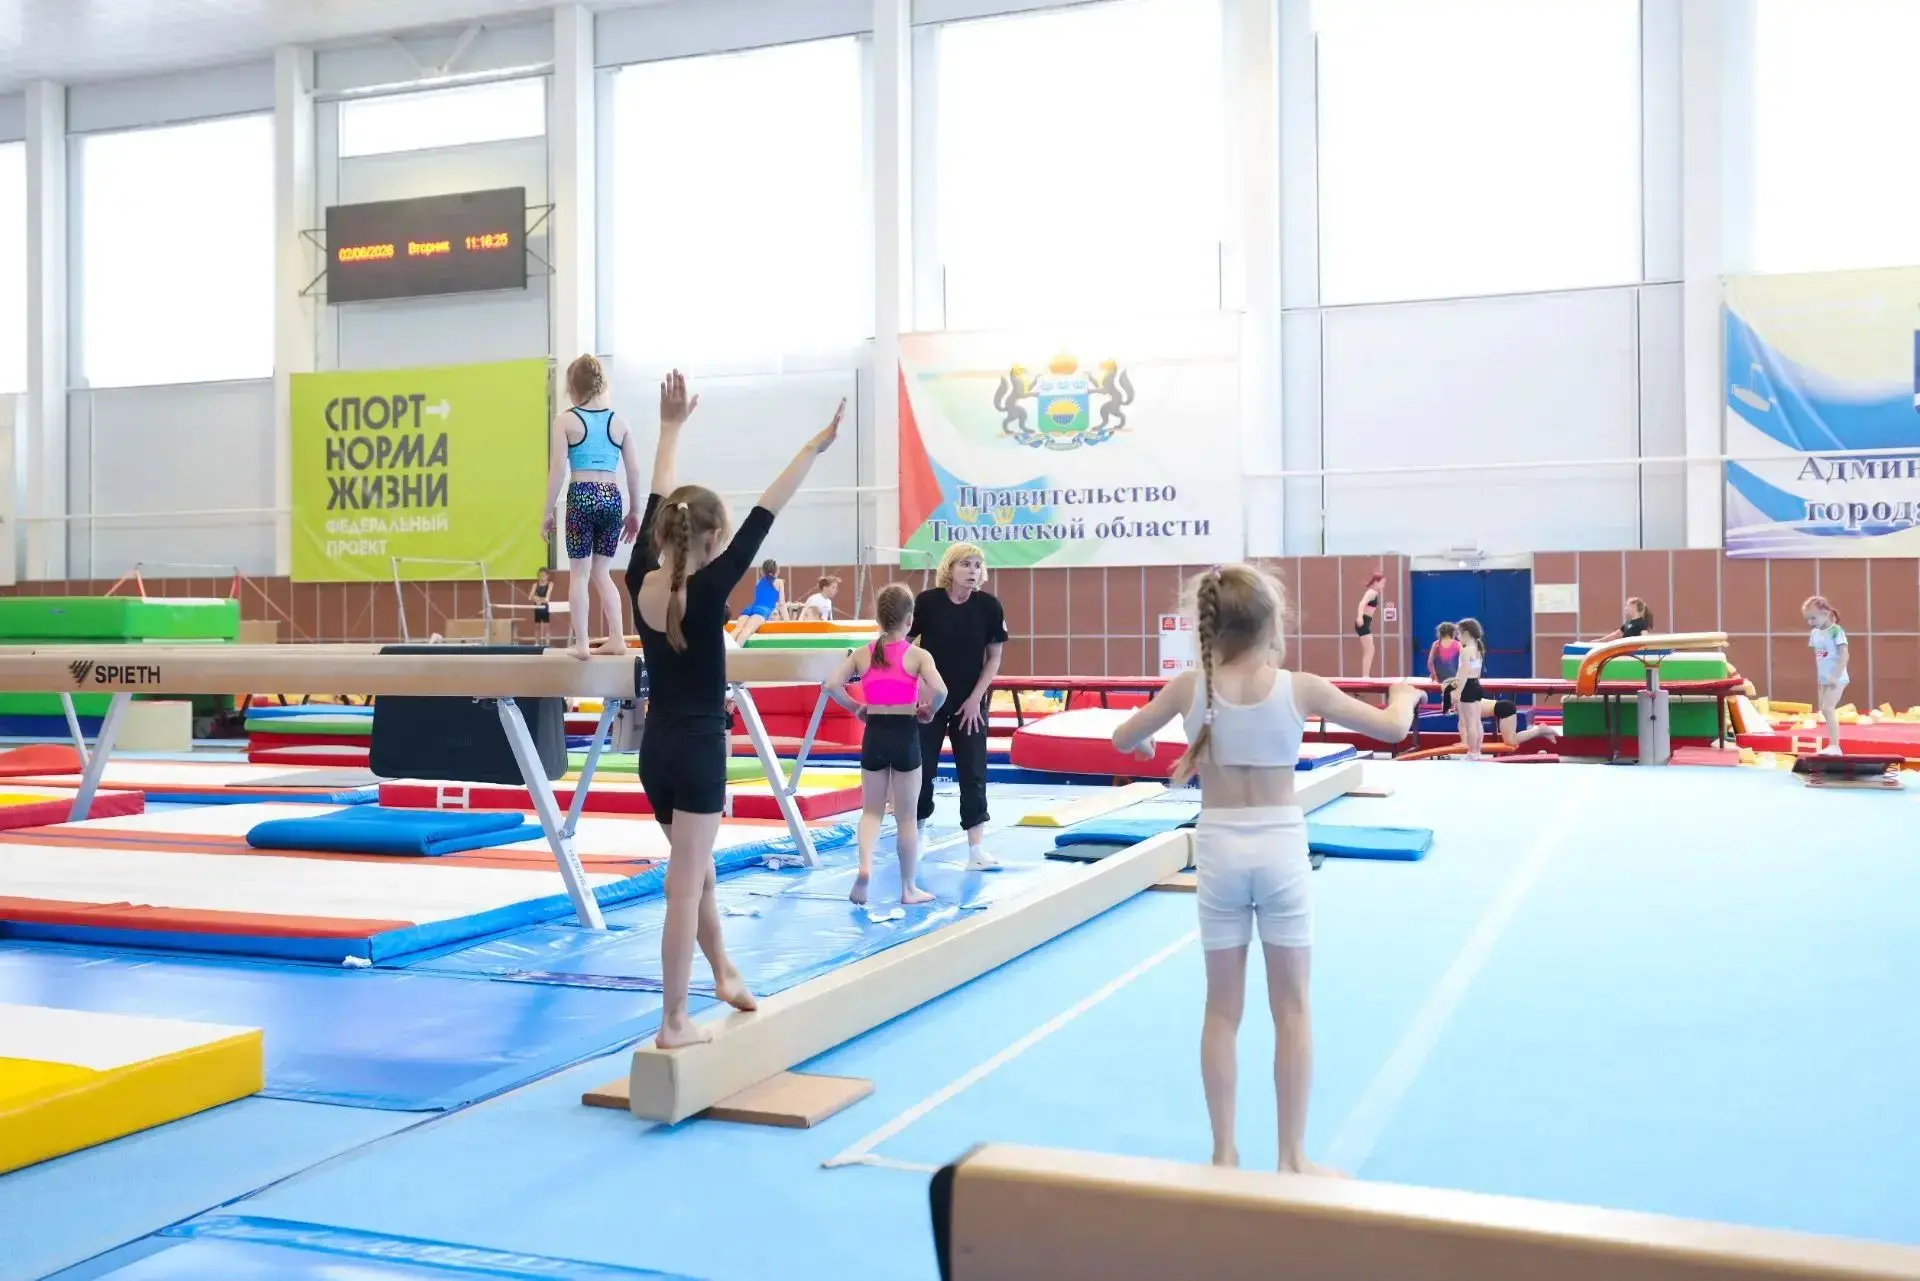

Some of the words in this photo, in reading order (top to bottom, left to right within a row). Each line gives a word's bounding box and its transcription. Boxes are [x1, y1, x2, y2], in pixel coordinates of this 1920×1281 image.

[325, 394, 426, 432] СПОРТ
[326, 432, 448, 471] НОРМА
[326, 472, 448, 510] ЖИЗНИ
[958, 484, 1177, 514] Правительство
[326, 512, 448, 536] ФЕДЕРАЛЬНЫЙ
[1807, 502, 1920, 528] город
[928, 517, 1086, 543] Тюменской
[1095, 516, 1211, 539] области
[326, 539, 388, 558] ПРОЕКТ
[95, 665, 161, 684] SPIETH
